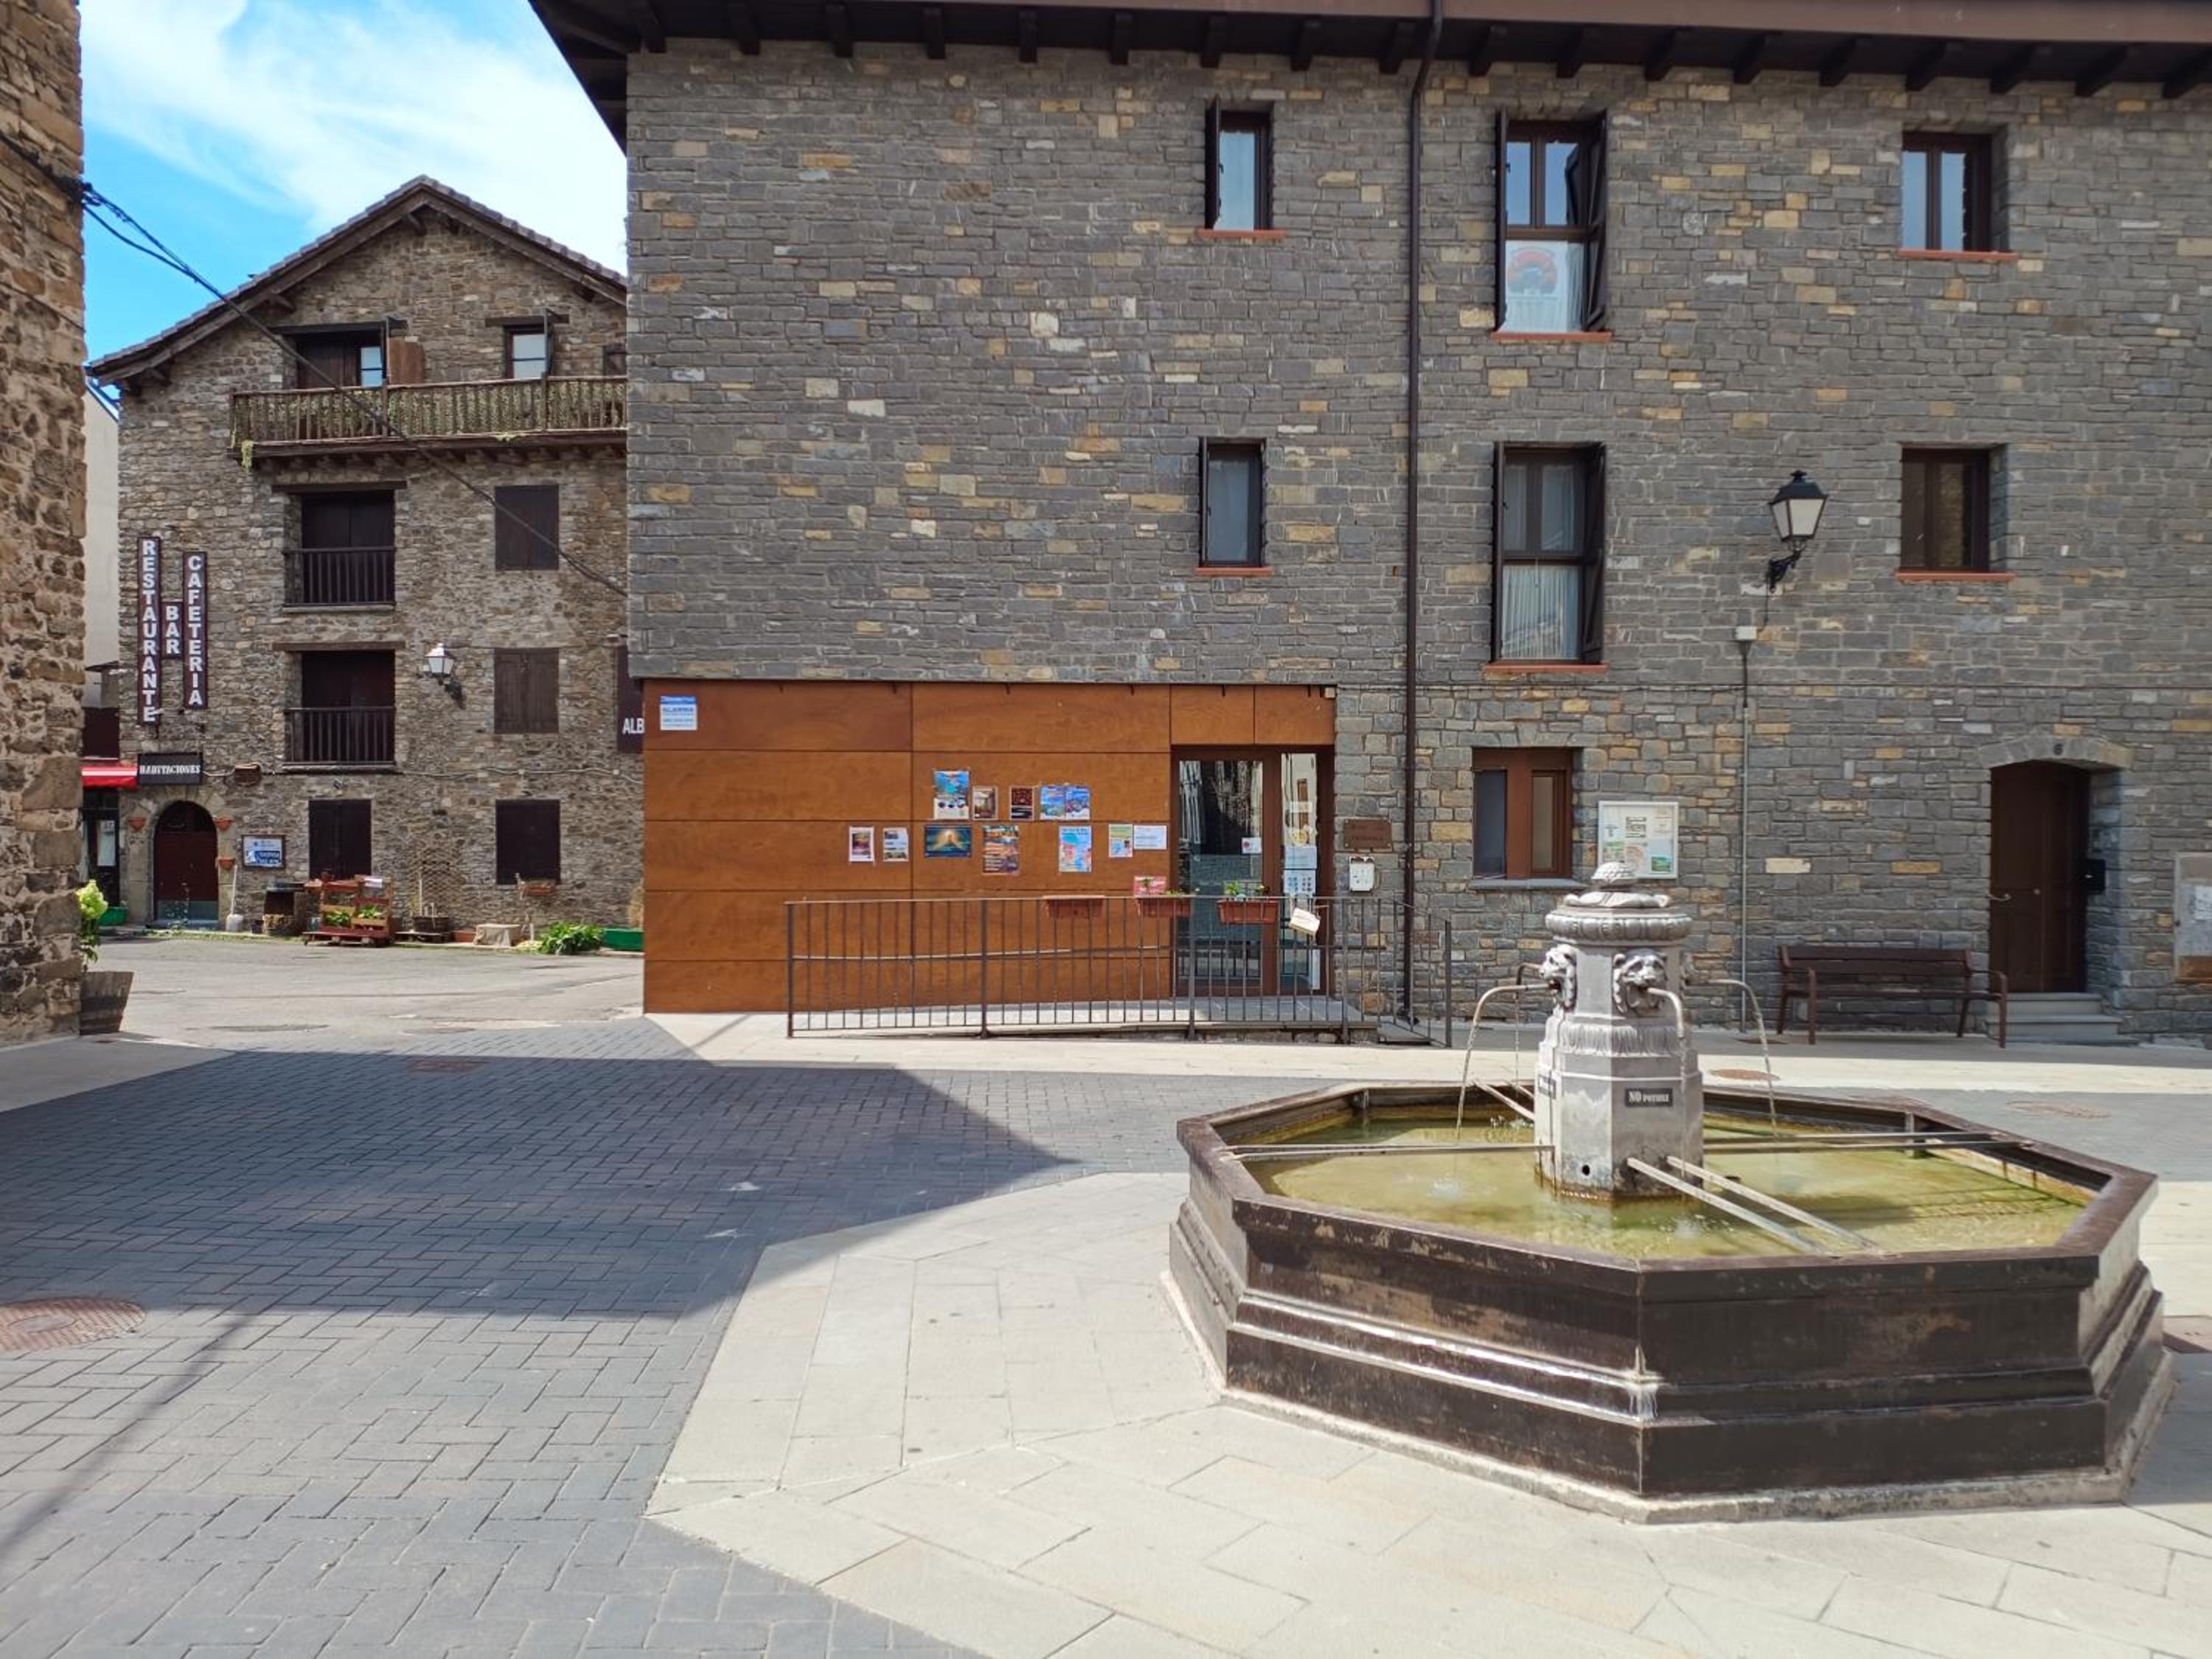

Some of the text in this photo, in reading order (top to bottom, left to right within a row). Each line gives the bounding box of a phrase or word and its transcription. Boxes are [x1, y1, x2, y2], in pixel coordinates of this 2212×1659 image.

[142, 540, 157, 722] RESTAURANTE
[166, 605, 181, 654] BAR
[188, 555, 203, 706] CAFETERIA
[140, 765, 201, 774] HABITACIONES
[1629, 1091, 1641, 1102] NO
